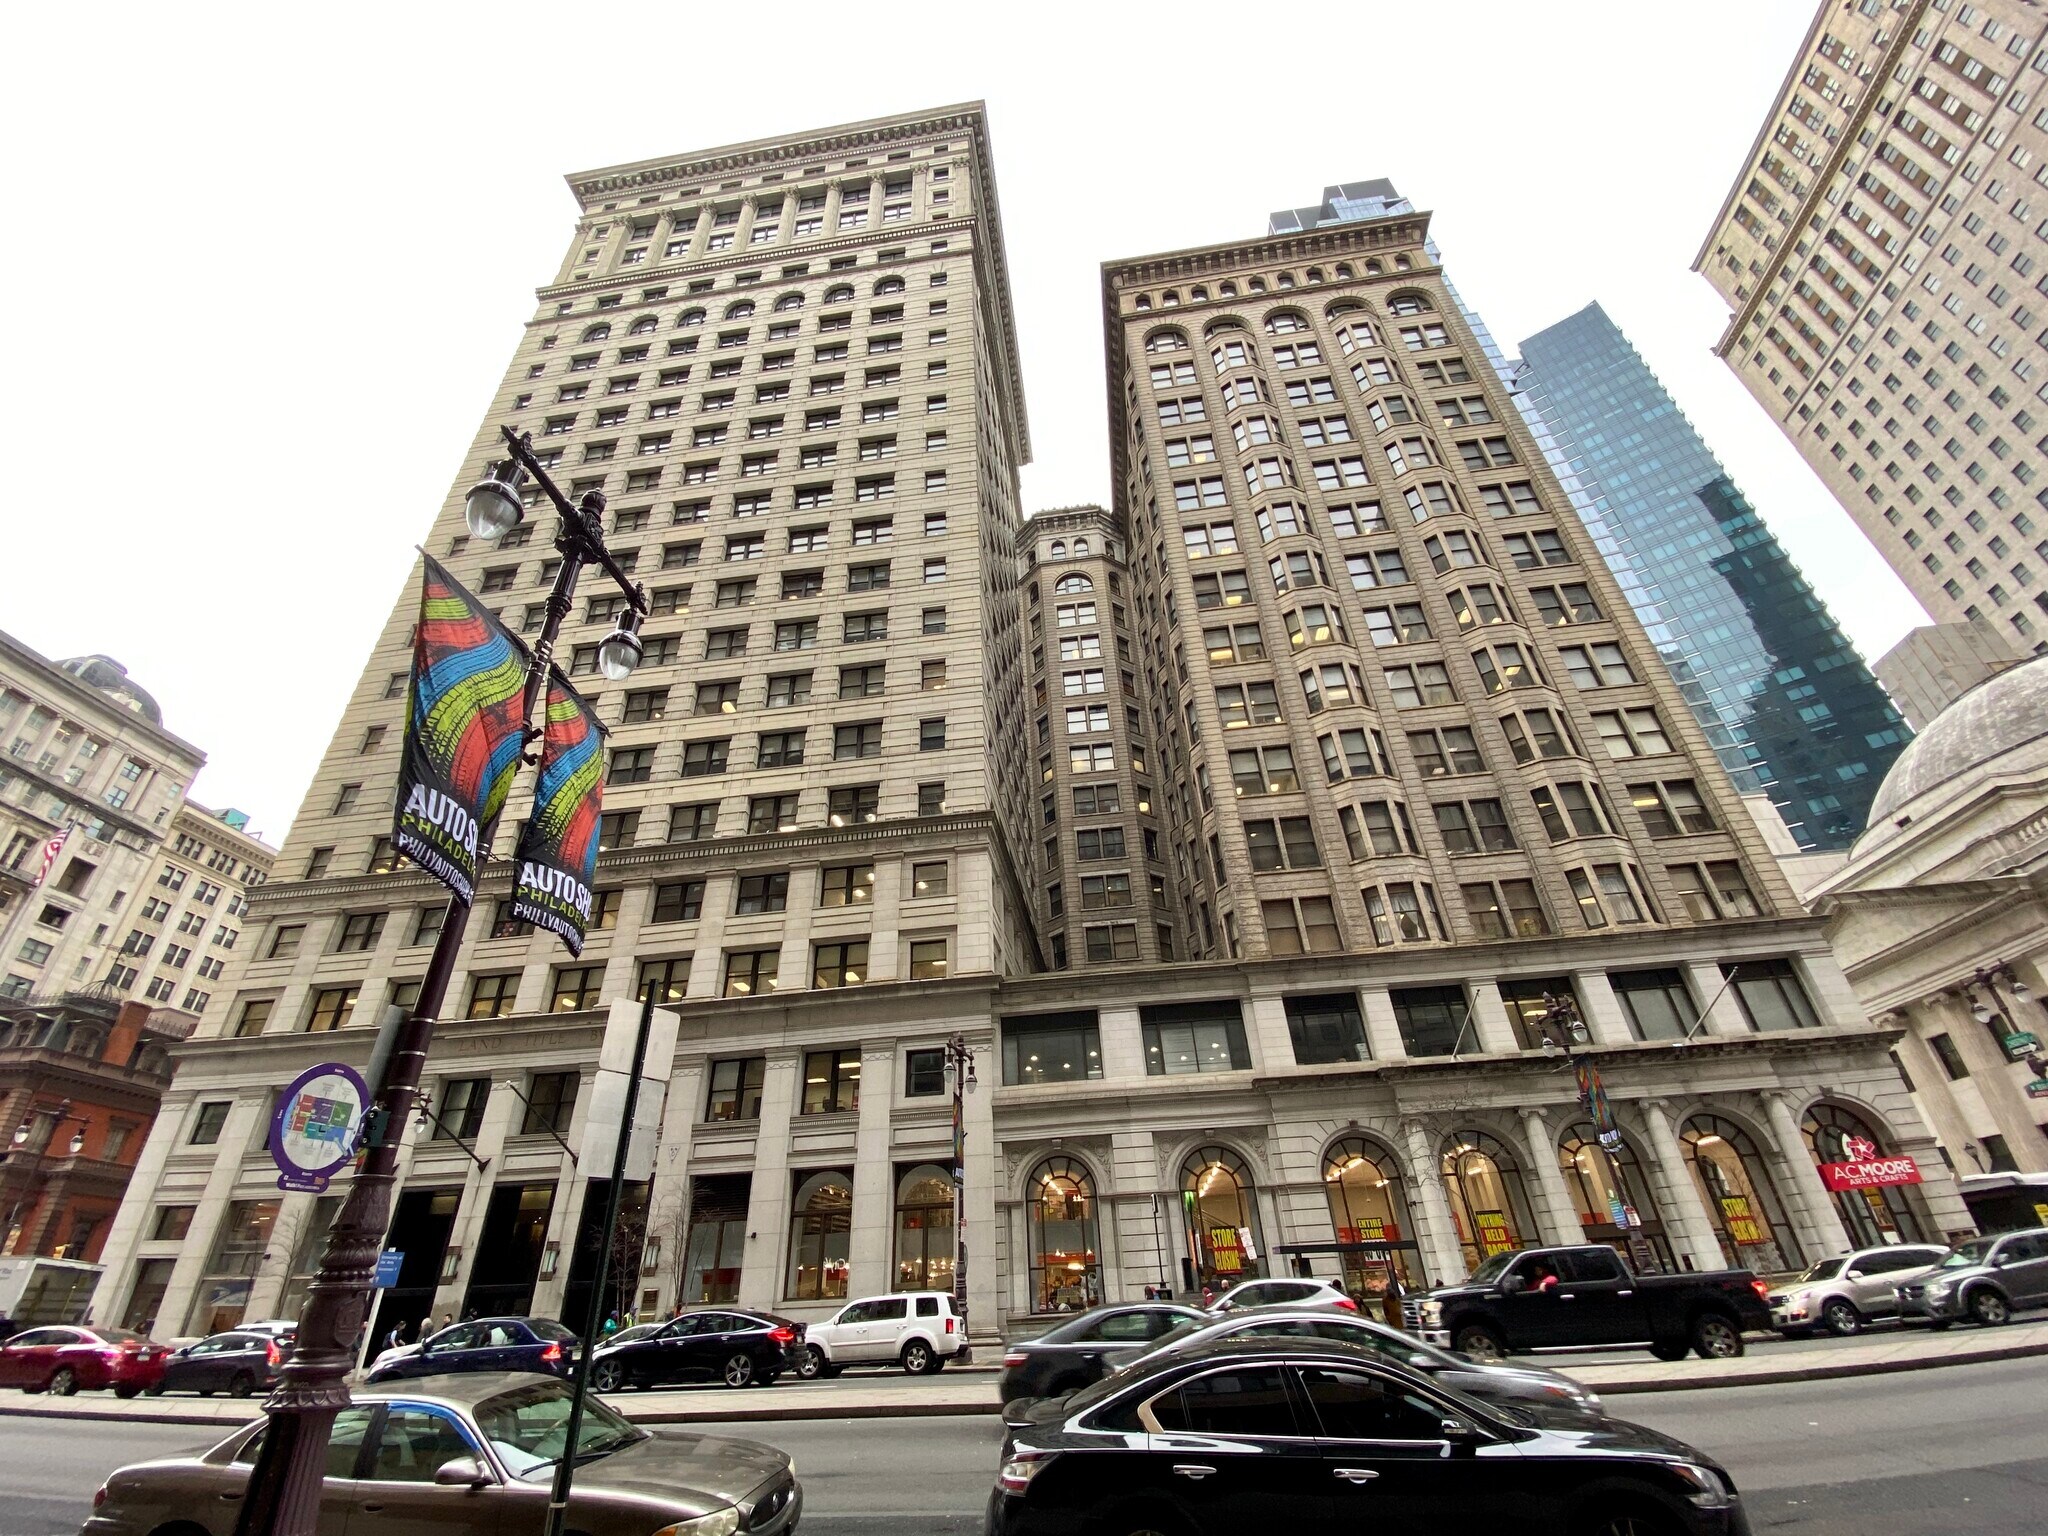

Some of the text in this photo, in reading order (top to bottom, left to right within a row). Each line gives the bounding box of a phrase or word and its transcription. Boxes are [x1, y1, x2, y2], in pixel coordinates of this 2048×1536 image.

[404, 783, 479, 862] AUTO SH
[519, 861, 576, 904] AUTO
[458, 1033, 568, 1052] LAND TITLE
[1850, 1173, 1909, 1186] ARTS & CRAFTS
[1357, 1218, 1383, 1228] ENTIRE
[1211, 1228, 1238, 1249] STORE
[1360, 1228, 1385, 1239] STORE
[1484, 1228, 1507, 1242] HELD
[1214, 1249, 1241, 1271] CLOSING
